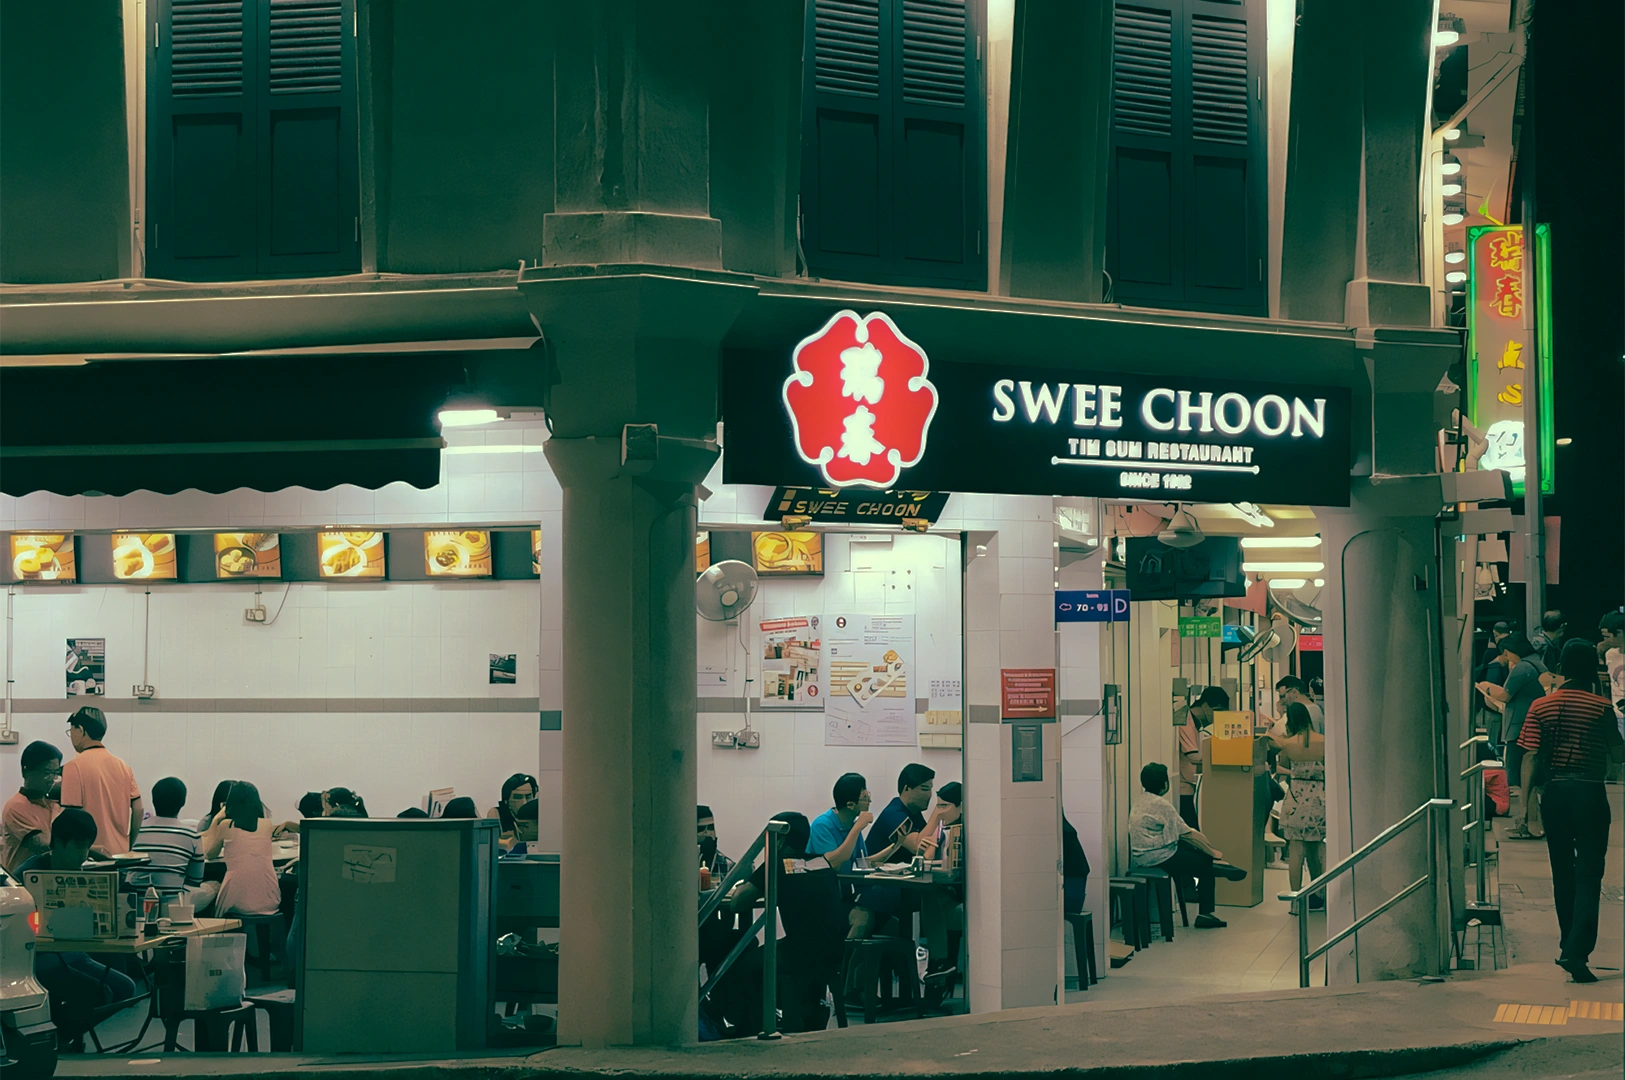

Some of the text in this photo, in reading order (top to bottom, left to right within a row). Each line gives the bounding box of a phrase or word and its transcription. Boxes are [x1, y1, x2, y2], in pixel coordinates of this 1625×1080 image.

[992, 379, 1326, 438] SWEE CHOON
[1068, 438, 1254, 463] TIM SUM RESTAURANT
[794, 500, 922, 517] SWEE CHOON
[1114, 598, 1128, 614] D
